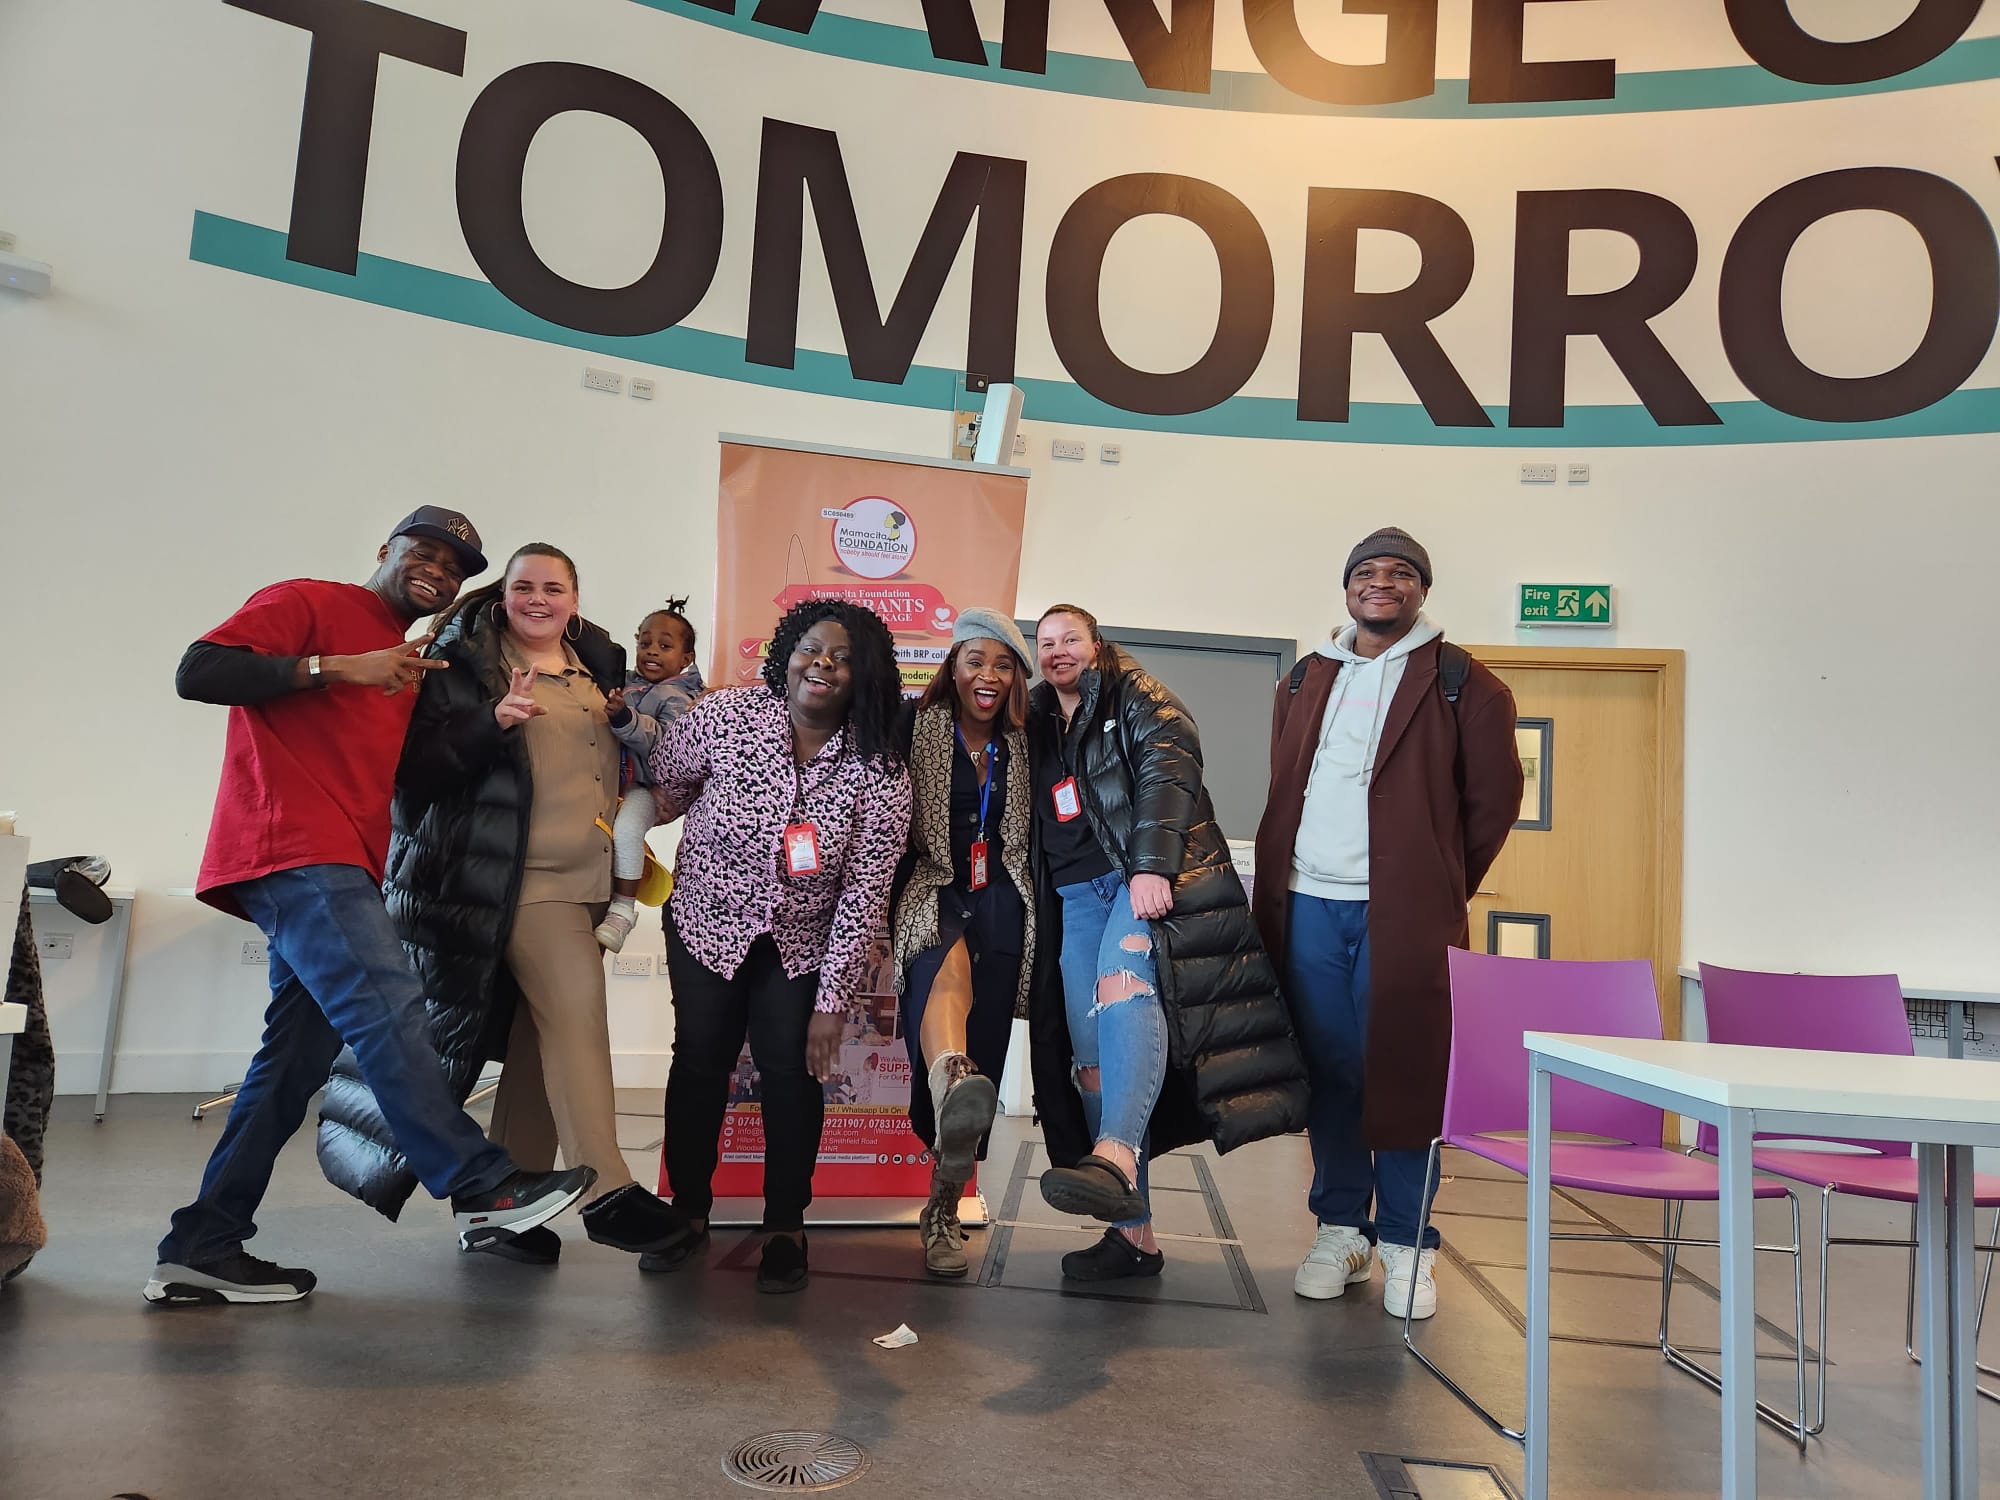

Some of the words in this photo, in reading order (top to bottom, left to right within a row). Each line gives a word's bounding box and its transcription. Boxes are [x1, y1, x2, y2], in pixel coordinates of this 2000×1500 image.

[222, 0, 2000, 427] TOMORRO
[840, 527, 887, 540] Mamacita
[839, 537, 908, 553] FOUNDATION
[810, 589, 856, 598] Mamacita
[859, 589, 910, 598] Foundation
[1524, 588, 1551, 600] Fire
[1524, 605, 1549, 616] exit
[876, 613, 912, 622] KAGE
[913, 649, 930, 659] BRP
[900, 670, 935, 680] modatio
[879, 1063, 912, 1073] SUPP
[824, 1105, 836, 1113] ext
[879, 1106, 889, 1114] Us
[868, 1119, 912, 1129] 07831265
